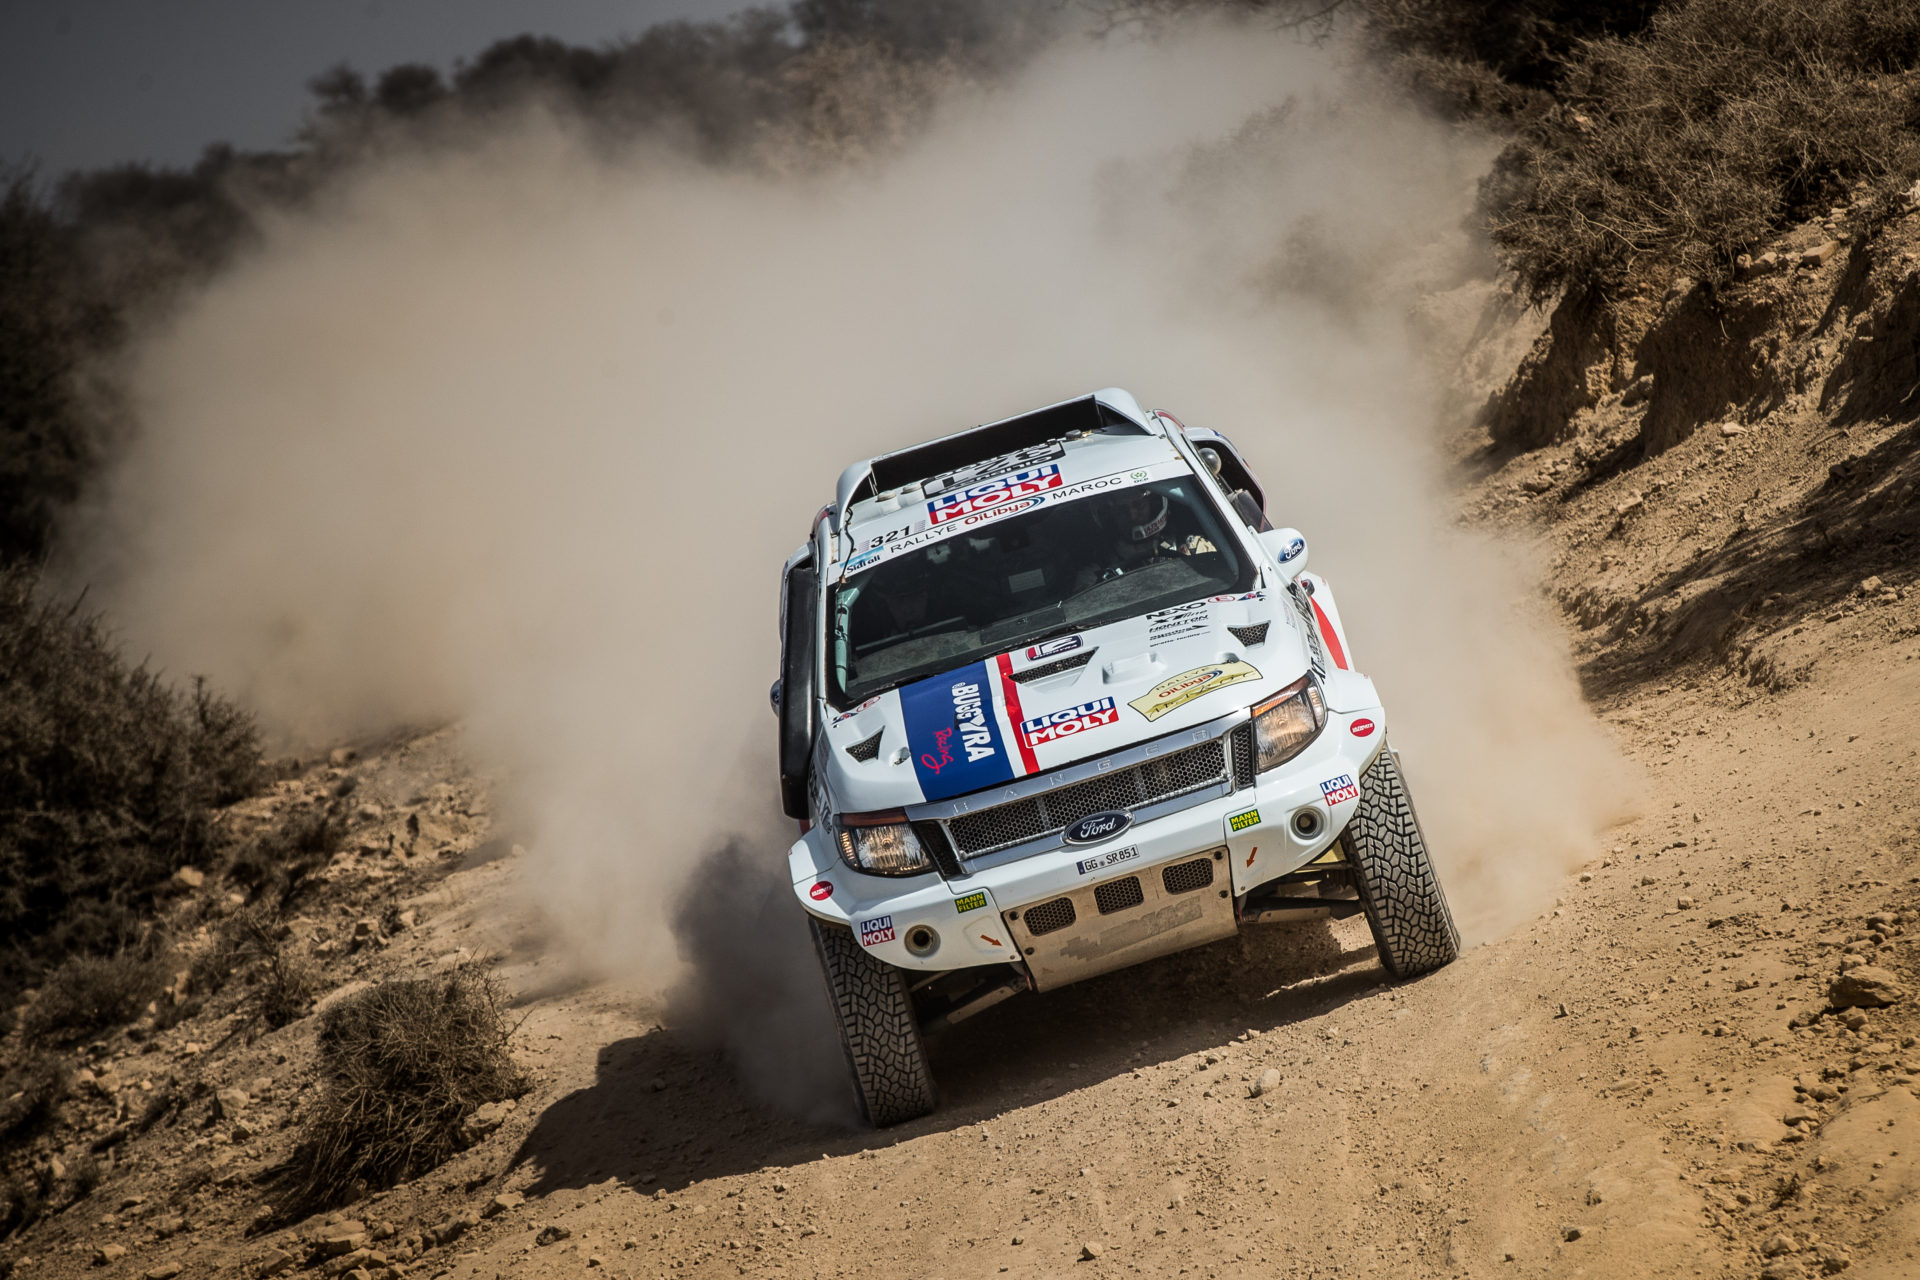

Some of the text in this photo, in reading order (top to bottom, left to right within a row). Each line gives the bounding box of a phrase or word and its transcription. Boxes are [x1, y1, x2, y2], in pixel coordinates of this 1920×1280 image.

[934, 465, 1053, 510] LIQUI
[935, 473, 1059, 522] MOLY
[891, 524, 957, 553] RALLYE
[1053, 478, 1122, 500] MAROC
[870, 526, 910, 548] 321
[1284, 541, 1303, 559] Ford
[1146, 602, 1207, 620] NEXO
[952, 683, 995, 763] BUGGYRA
[1026, 698, 1112, 732] LIQUI
[1028, 709, 1115, 746] MOLY
[921, 727, 954, 775] Racing
[1321, 775, 1352, 794] LIQUI
[1326, 786, 1358, 806] MOLY
[1231, 809, 1258, 823] MANN
[1232, 817, 1260, 831] FILTER
[1080, 816, 1117, 839] Ford
[1084, 847, 1138, 871] GG SR 851
[956, 893, 984, 905] MANN
[957, 899, 986, 913] FILTER
[861, 915, 891, 932] LIQUI
[862, 927, 895, 946] MOLY
